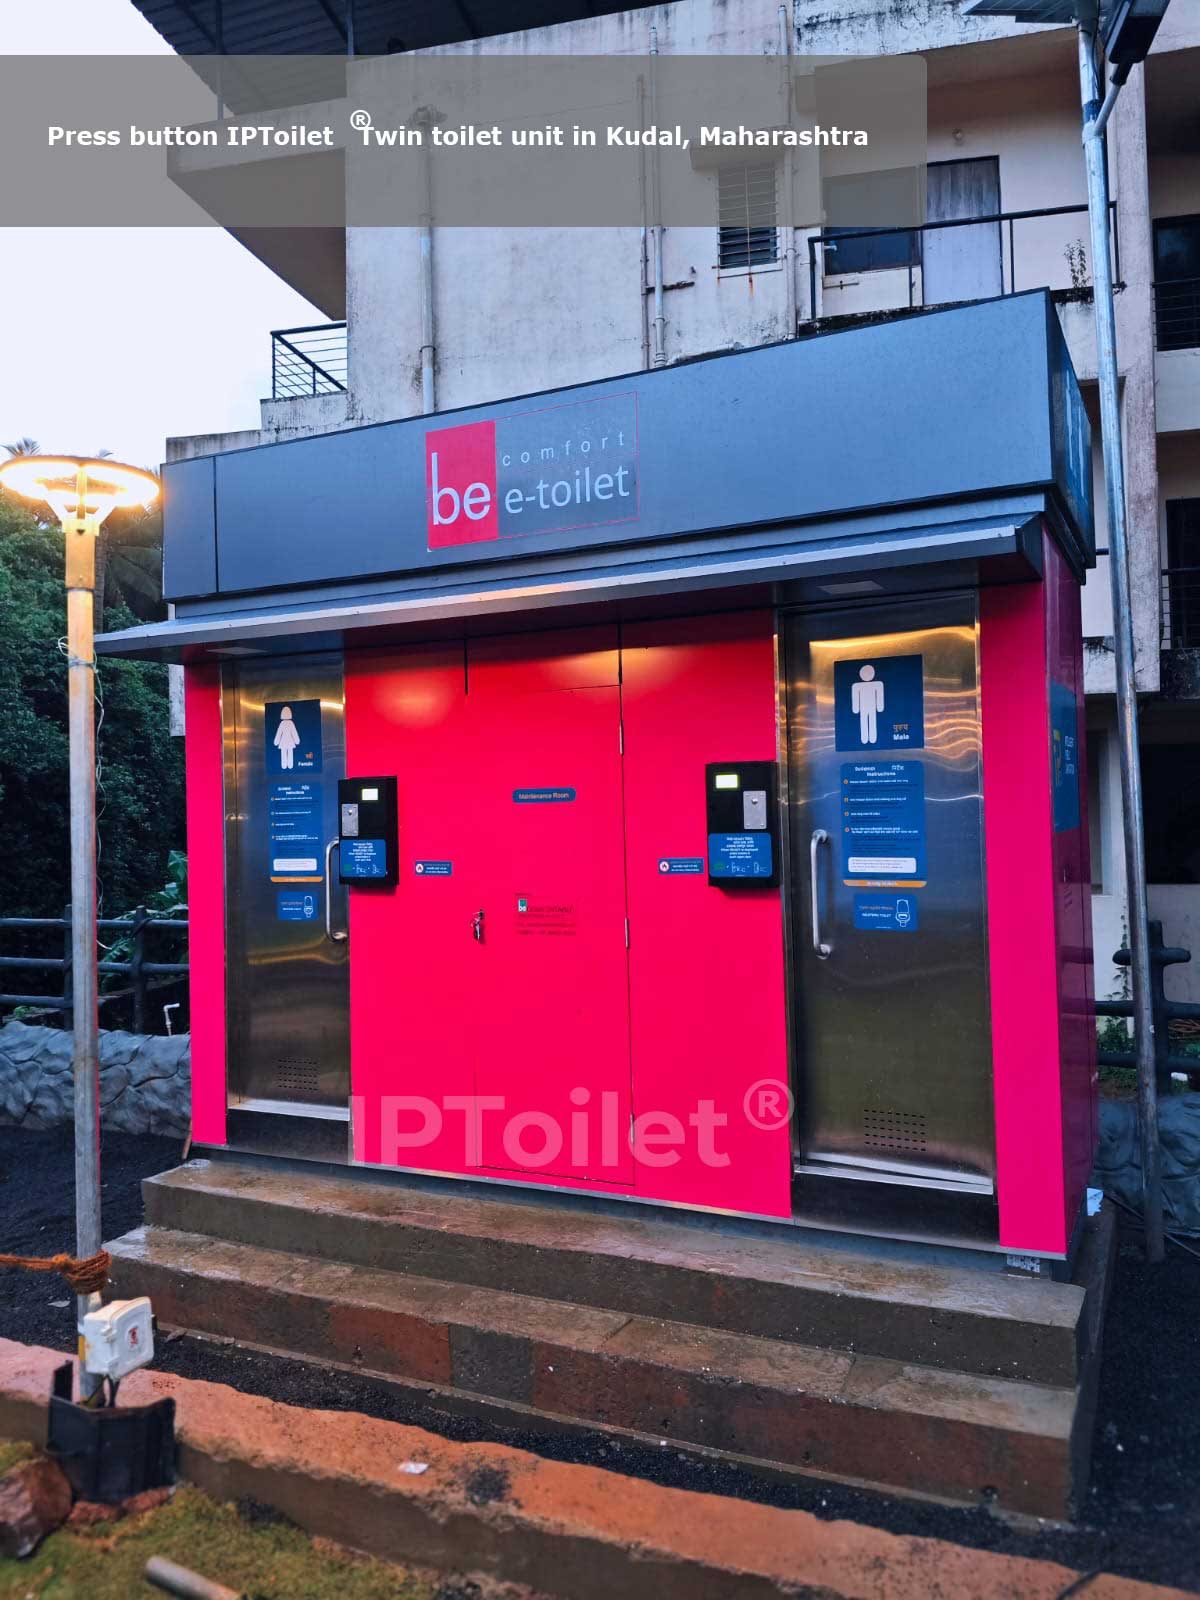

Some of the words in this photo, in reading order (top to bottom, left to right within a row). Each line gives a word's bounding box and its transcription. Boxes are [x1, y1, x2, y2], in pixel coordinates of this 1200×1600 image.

[503, 431, 625, 466] comfort
[431, 452, 491, 525] be
[505, 465, 630, 514] e-toilet
